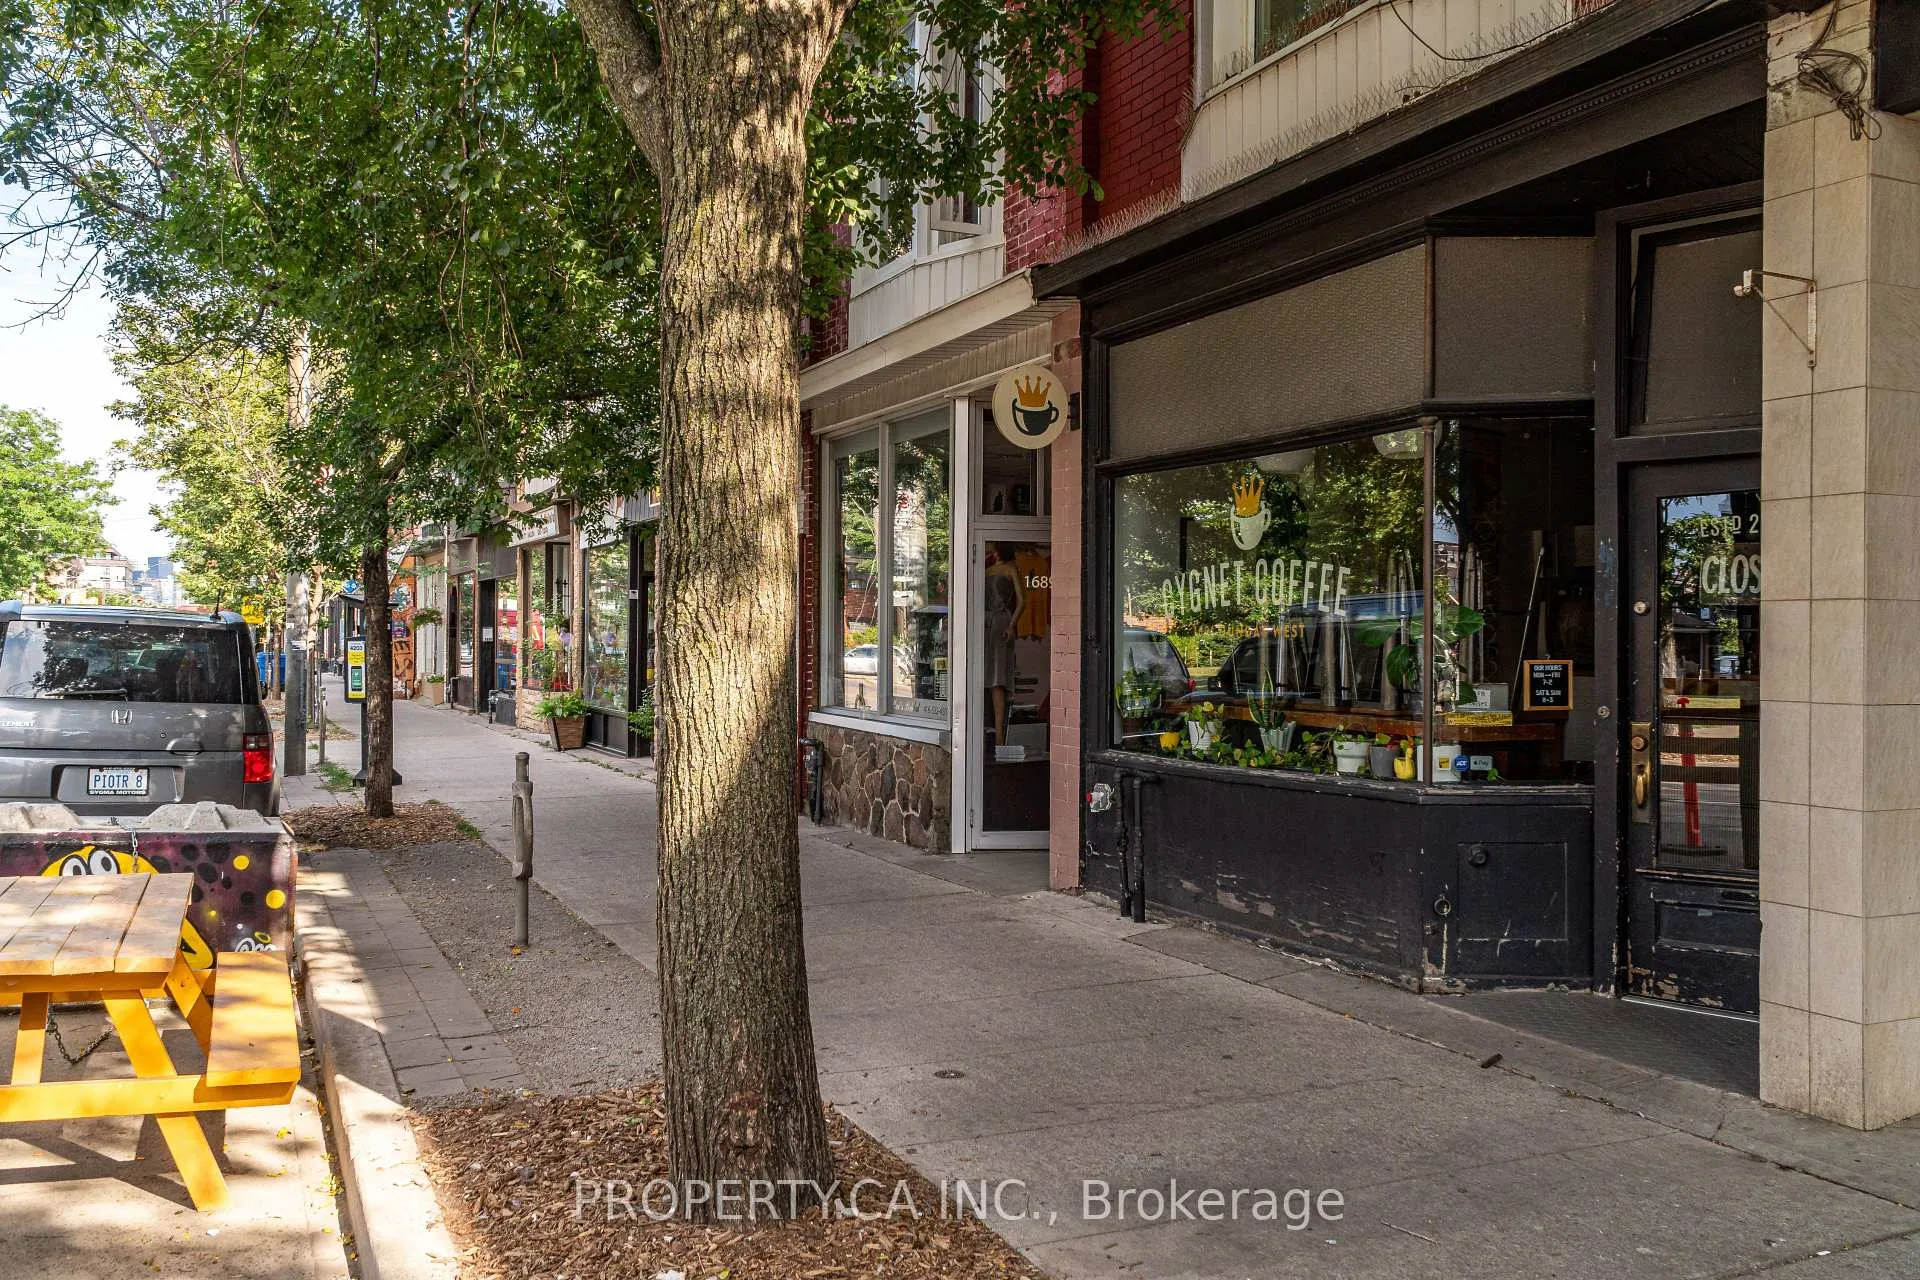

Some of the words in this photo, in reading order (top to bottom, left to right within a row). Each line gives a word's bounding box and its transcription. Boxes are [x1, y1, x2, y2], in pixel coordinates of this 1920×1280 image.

[1162, 560, 1244, 617] CYGNET
[1255, 558, 1350, 616] COFFEE
[93, 774, 129, 788] PIOTR
[136, 775, 143, 788] 8
